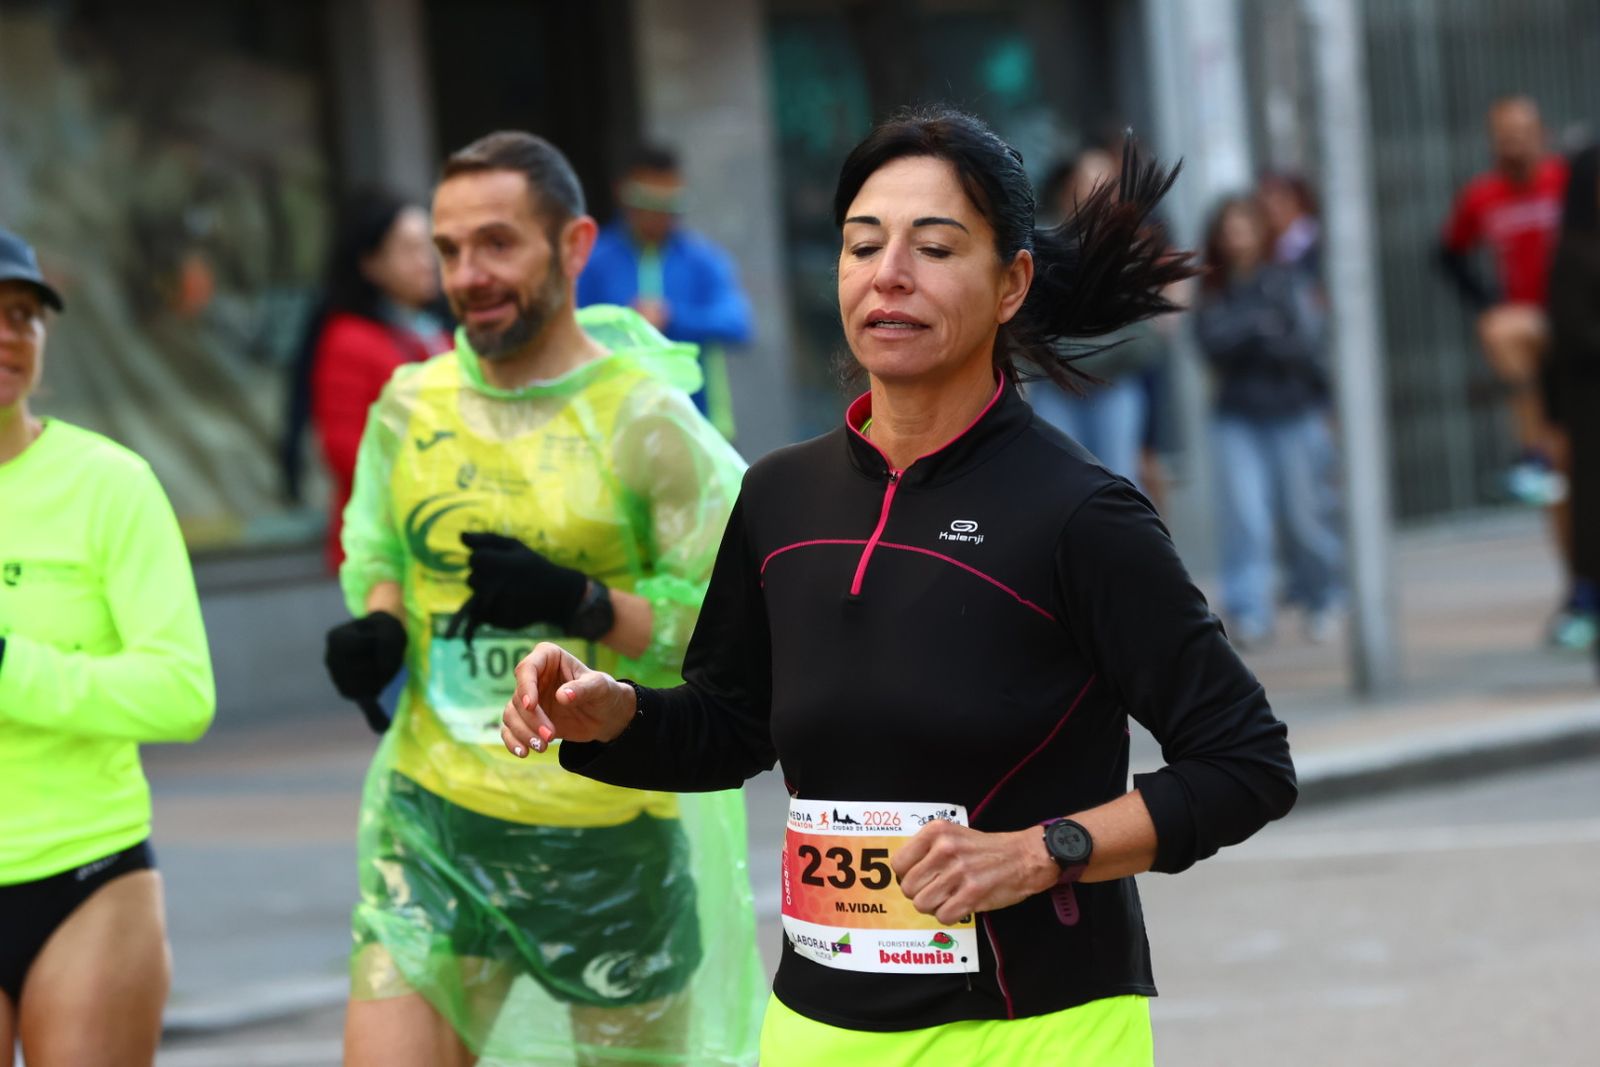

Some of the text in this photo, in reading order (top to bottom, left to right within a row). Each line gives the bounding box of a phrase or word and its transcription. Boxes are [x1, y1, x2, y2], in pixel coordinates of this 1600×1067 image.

[938, 531, 985, 545] Kalenji
[863, 810, 902, 826] 2026
[798, 844, 903, 891] 235
[835, 902, 888, 914] M.VIDAL
[878, 940, 926, 948] FLORISTERÍAS
[879, 949, 954, 965] bedunia
